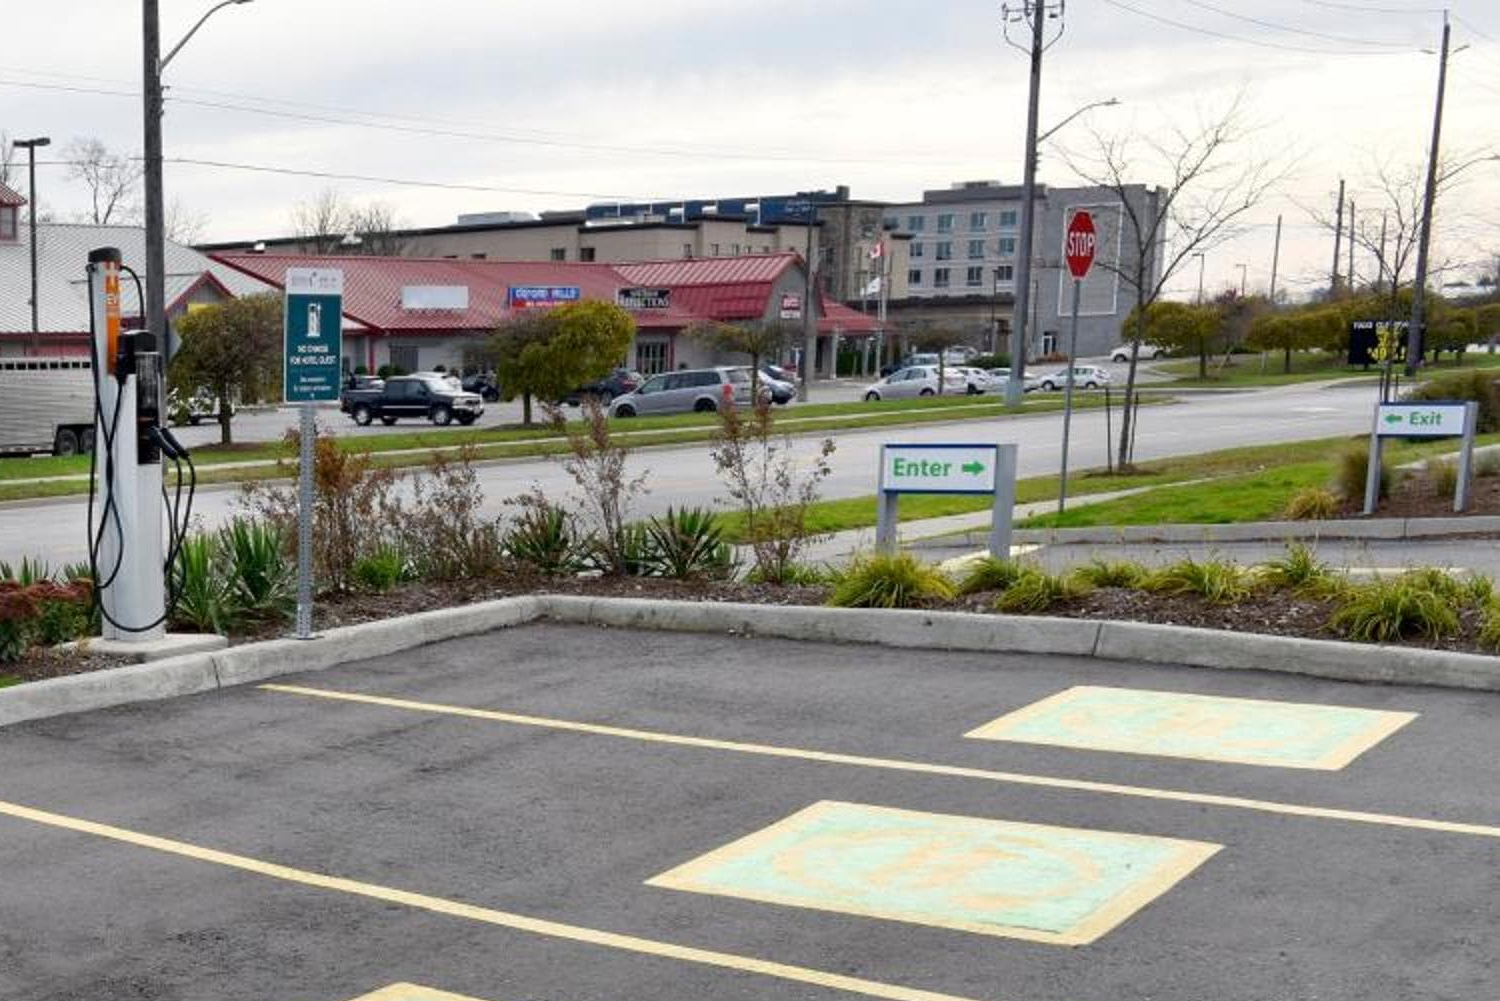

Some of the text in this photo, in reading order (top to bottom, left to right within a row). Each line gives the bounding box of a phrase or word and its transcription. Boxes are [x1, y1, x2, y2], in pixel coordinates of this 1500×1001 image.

[1068, 232, 1095, 256] STOP
[1410, 411, 1443, 425] Exit
[893, 458, 952, 477] Enter
